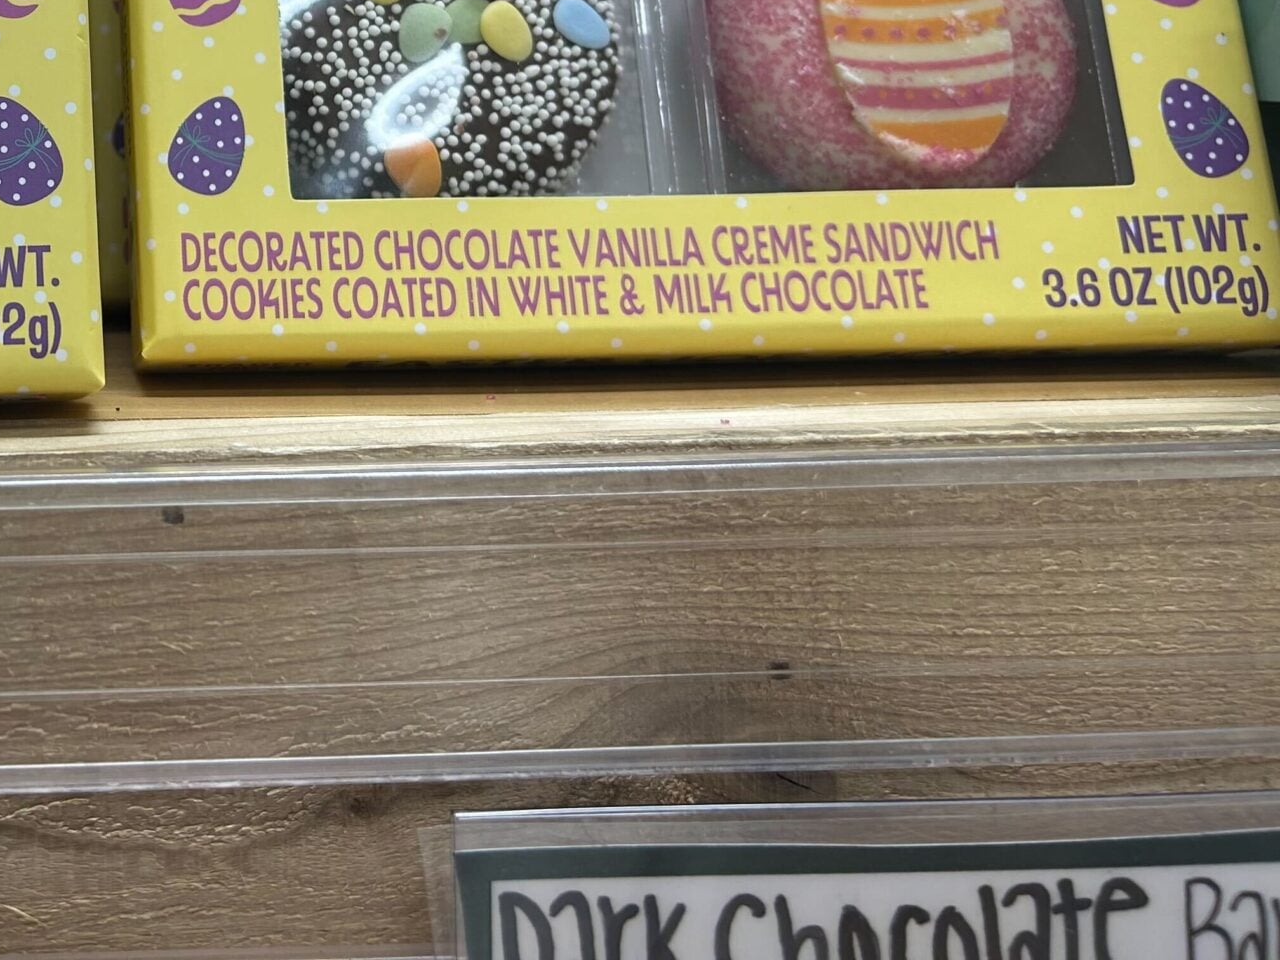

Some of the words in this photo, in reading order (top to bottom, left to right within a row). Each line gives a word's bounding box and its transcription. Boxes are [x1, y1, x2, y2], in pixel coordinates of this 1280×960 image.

[180, 230, 364, 273] DECORATED
[373, 228, 562, 271] CHOCOLATE
[567, 226, 704, 269] VANILLA
[713, 224, 817, 266] CREME
[825, 220, 1000, 264] SANDWICH
[1116, 214, 1185, 254] NET
[1192, 213, 1261, 253] WT.
[182, 277, 324, 321] COOKIES
[332, 276, 457, 319] COATED
[466, 276, 501, 318] IN
[508, 274, 609, 317] WHITE
[619, 273, 645, 315] &
[653, 271, 732, 314] MILK
[741, 268, 929, 313] CHOCOLATE
[1041, 267, 1101, 308] 3.6
[1108, 266, 1157, 307] OZ
[1164, 265, 1269, 317] (102g)
[1183, 876, 1280, 960] Ba
